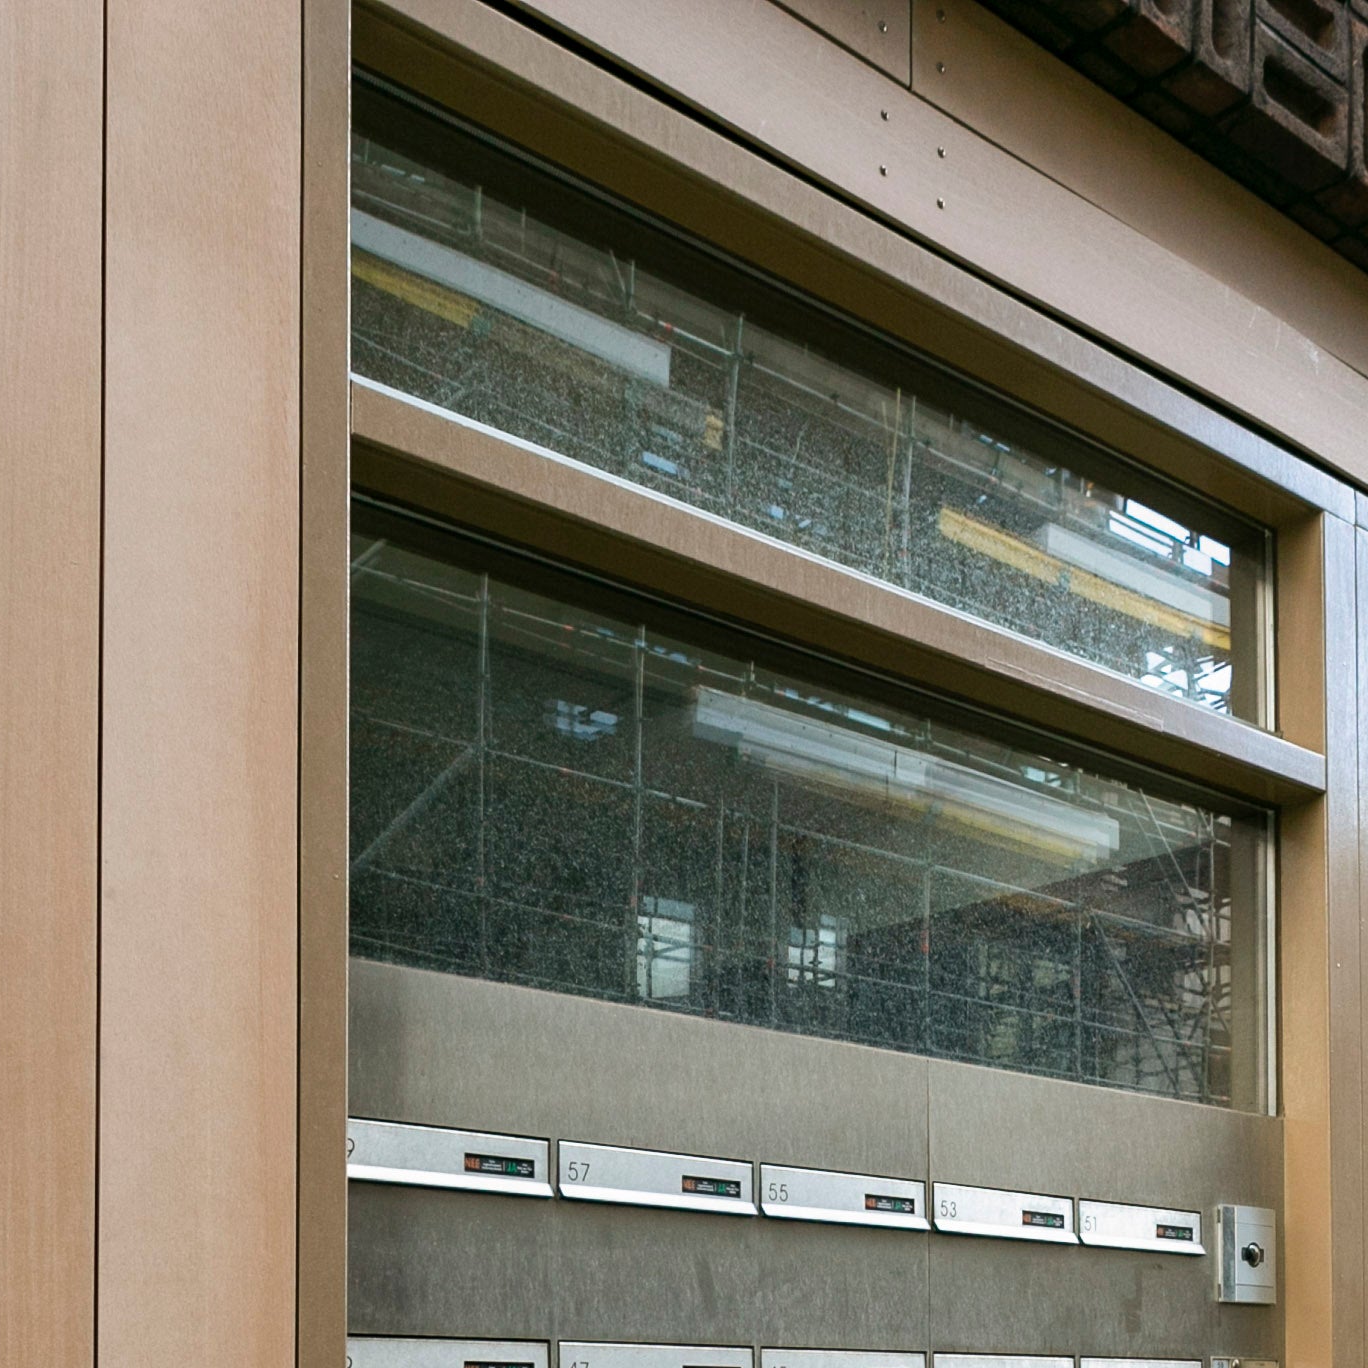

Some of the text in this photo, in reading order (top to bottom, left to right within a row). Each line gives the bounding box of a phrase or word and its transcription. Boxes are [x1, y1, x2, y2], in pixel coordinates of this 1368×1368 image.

[465, 1158, 480, 1168] NEE
[507, 1162, 518, 1174] JA
[568, 1162, 590, 1181] 57
[769, 1183, 788, 1201] 55
[941, 1200, 956, 1217] 53
[1084, 1216, 1097, 1232] 51
